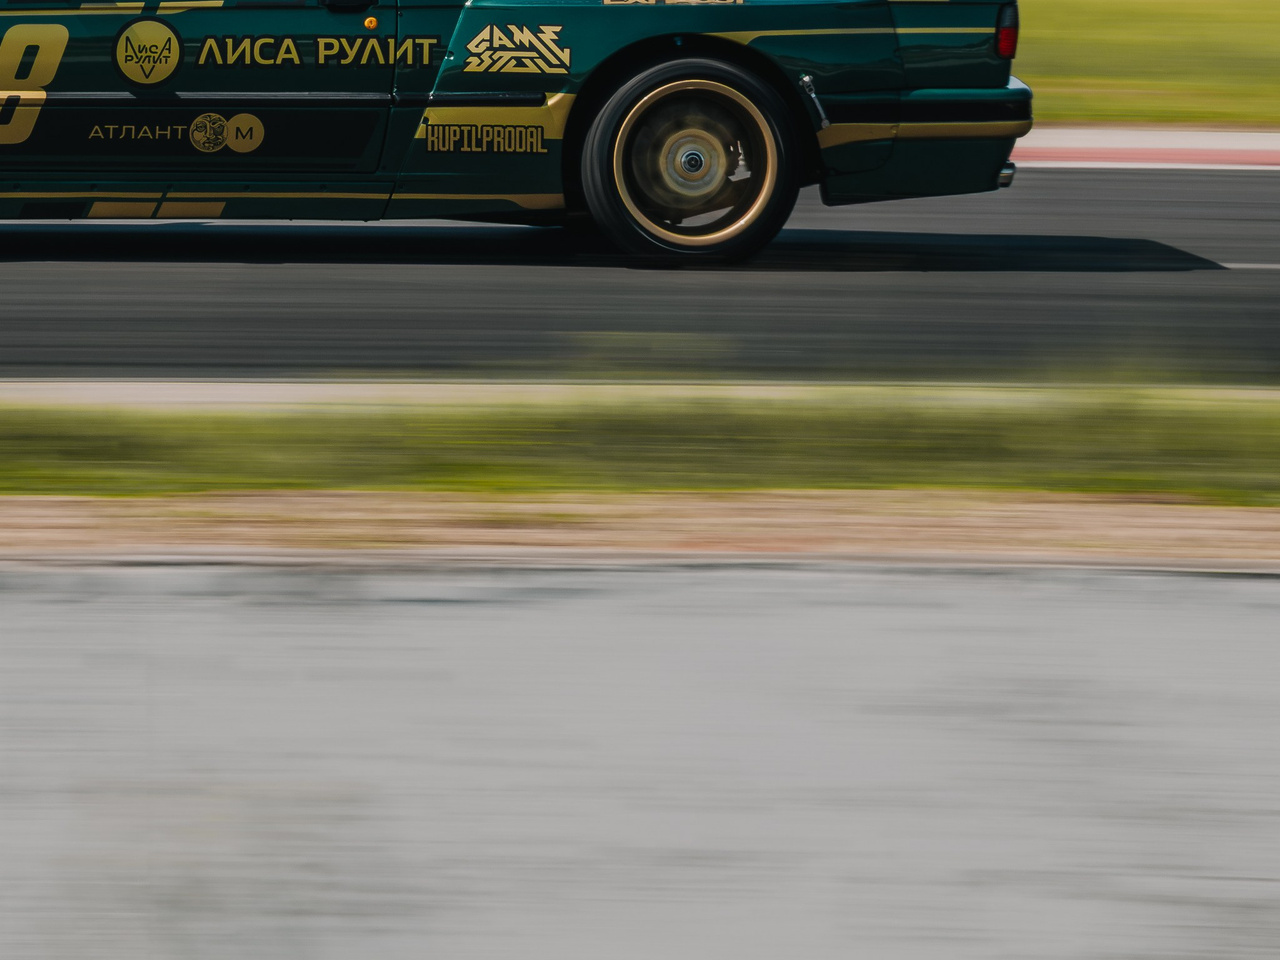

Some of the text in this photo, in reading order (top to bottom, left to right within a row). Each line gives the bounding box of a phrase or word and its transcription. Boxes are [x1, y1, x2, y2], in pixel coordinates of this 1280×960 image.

[198, 38, 438, 65] ЛИСА РУЛИТ
[466, 24, 571, 68] GAME
[88, 125, 188, 140] АТЛАНТ
[427, 125, 548, 153] KUPILPRODAL
